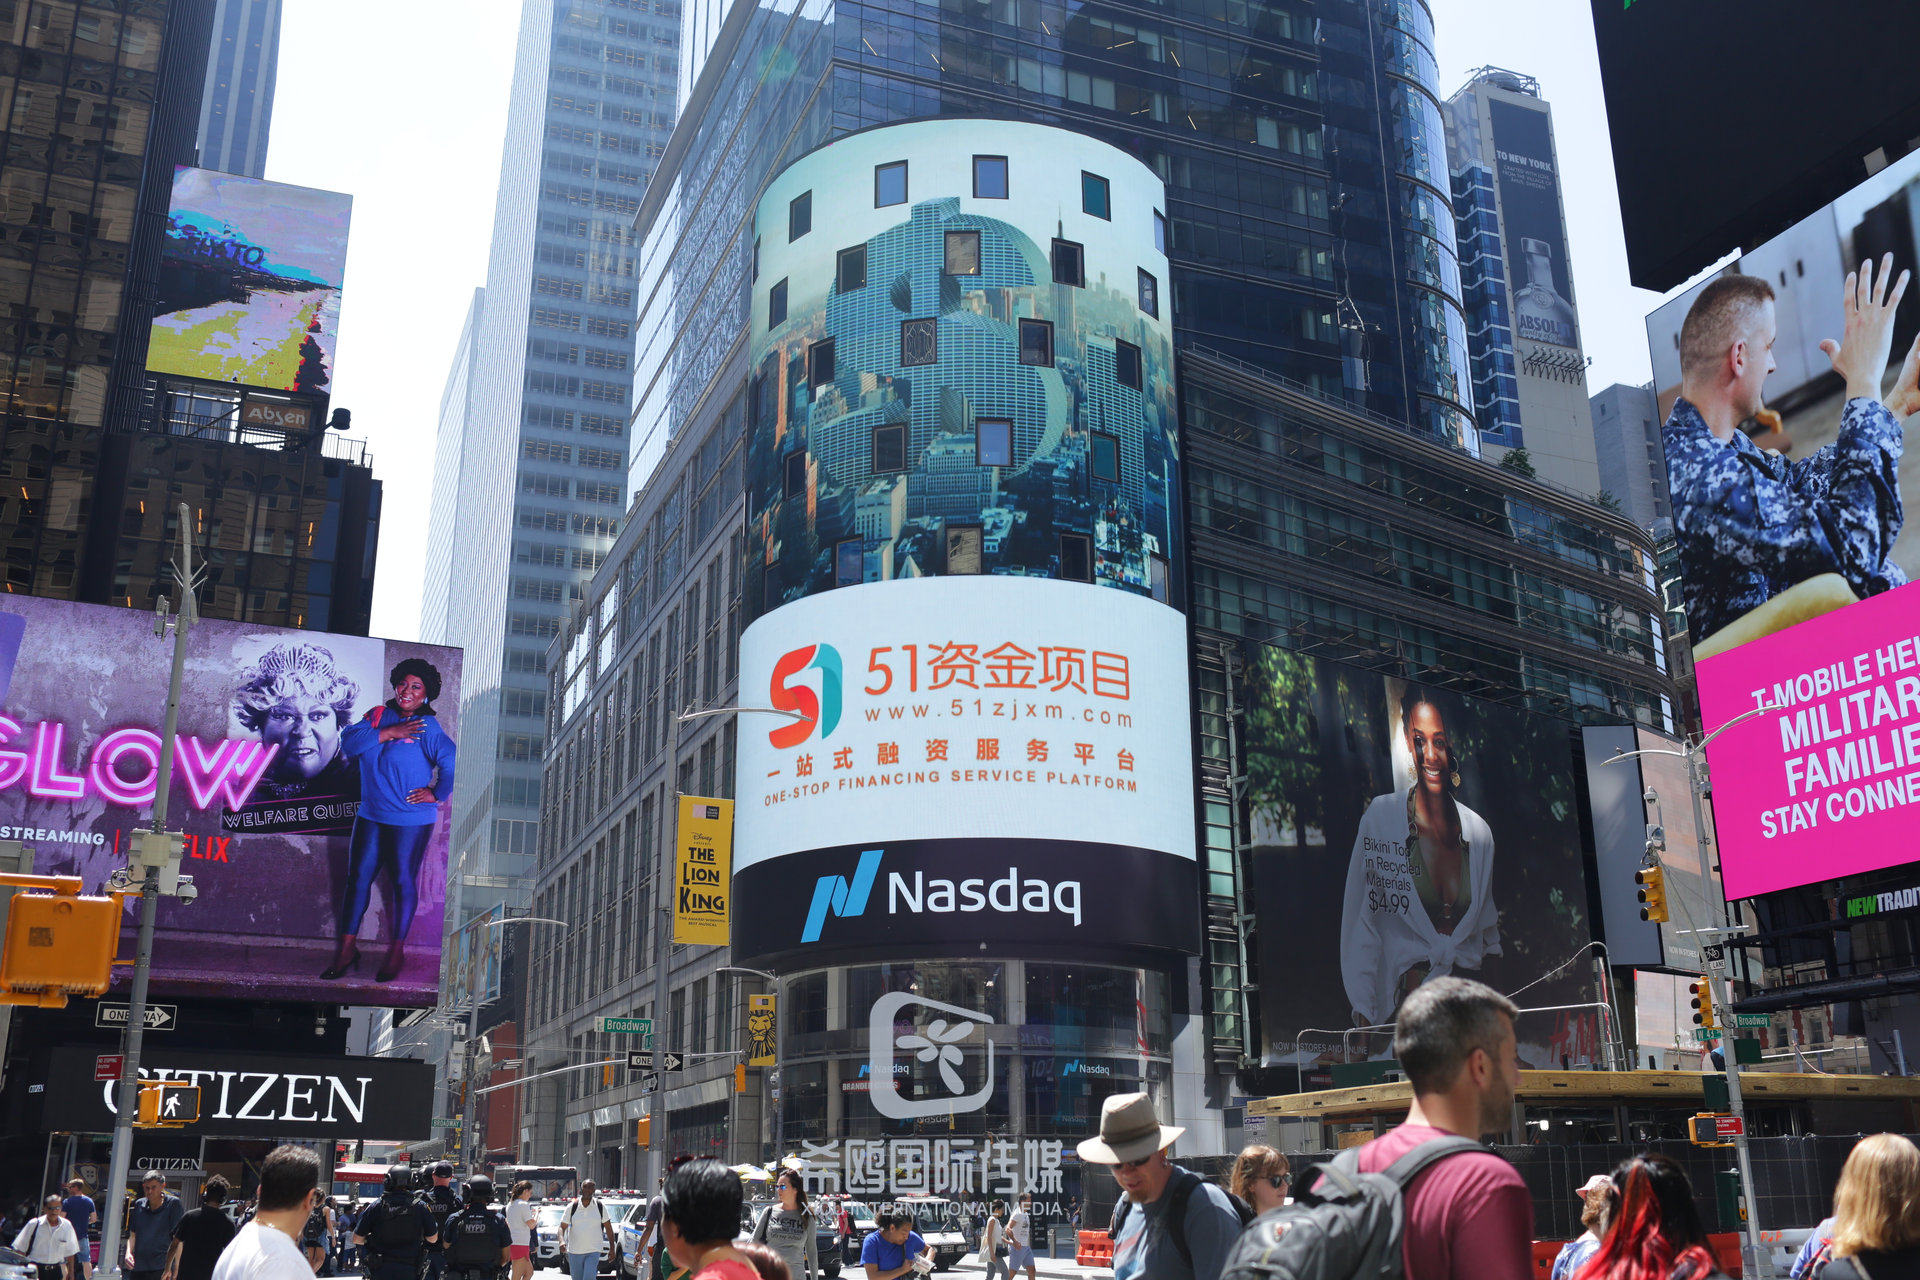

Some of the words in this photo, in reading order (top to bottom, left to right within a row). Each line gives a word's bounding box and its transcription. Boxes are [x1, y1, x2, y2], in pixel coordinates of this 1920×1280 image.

[1496, 150, 1508, 161] TO
[1508, 153, 1527, 165] NEW
[248, 406, 306, 426] Absen
[864, 640, 1131, 701] 51资金项目
[1751, 653, 1872, 717] T-MOBILE
[865, 699, 1132, 728] www.51zjxm.com
[1779, 673, 1920, 753] MILITAR
[1784, 721, 1920, 797] FAMILIE
[764, 780, 831, 807] ONE-STOP
[838, 770, 941, 790] FINANCING
[951, 769, 1037, 783] SERVICE
[1047, 771, 1138, 793] PLATFORM
[1760, 797, 1821, 839] STAY
[1825, 770, 1920, 823] CONNE
[223, 806, 309, 828] WELFARE
[0, 825, 105, 846] STREAMING
[690, 831, 712, 842] Disney
[688, 847, 714, 861] THE
[1364, 837, 1391, 854] Bikini
[1392, 841, 1411, 858] Top
[1365, 855, 1374, 868] in
[1376, 856, 1421, 877] Recycled
[1366, 872, 1411, 892] Materials
[888, 866, 1082, 927] Nasdaq
[1368, 889, 1409, 915] $4.99
[1712, 961, 1725, 969] LANE
[108, 1010, 129, 1020] ONE
[1738, 1016, 1768, 1026] Broadway
[607, 1019, 650, 1034] Broadway
[1697, 1030, 1704, 1039] W
[1272, 1042, 1290, 1051] NOW
[1300, 1042, 1327, 1053] STORES
[1328, 1044, 1343, 1054] AND
[1345, 1045, 1368, 1055] NLINE
[635, 1056, 652, 1065] ONE
[874, 1063, 910, 1075] Nasdaq
[1079, 1064, 1110, 1076] Nasdaq
[433, 1119, 460, 1128] BROADWAY
[137, 1157, 201, 1170] CITIZEN
[430, 1203, 448, 1212] NYPD
[465, 1224, 486, 1232] NYPD
